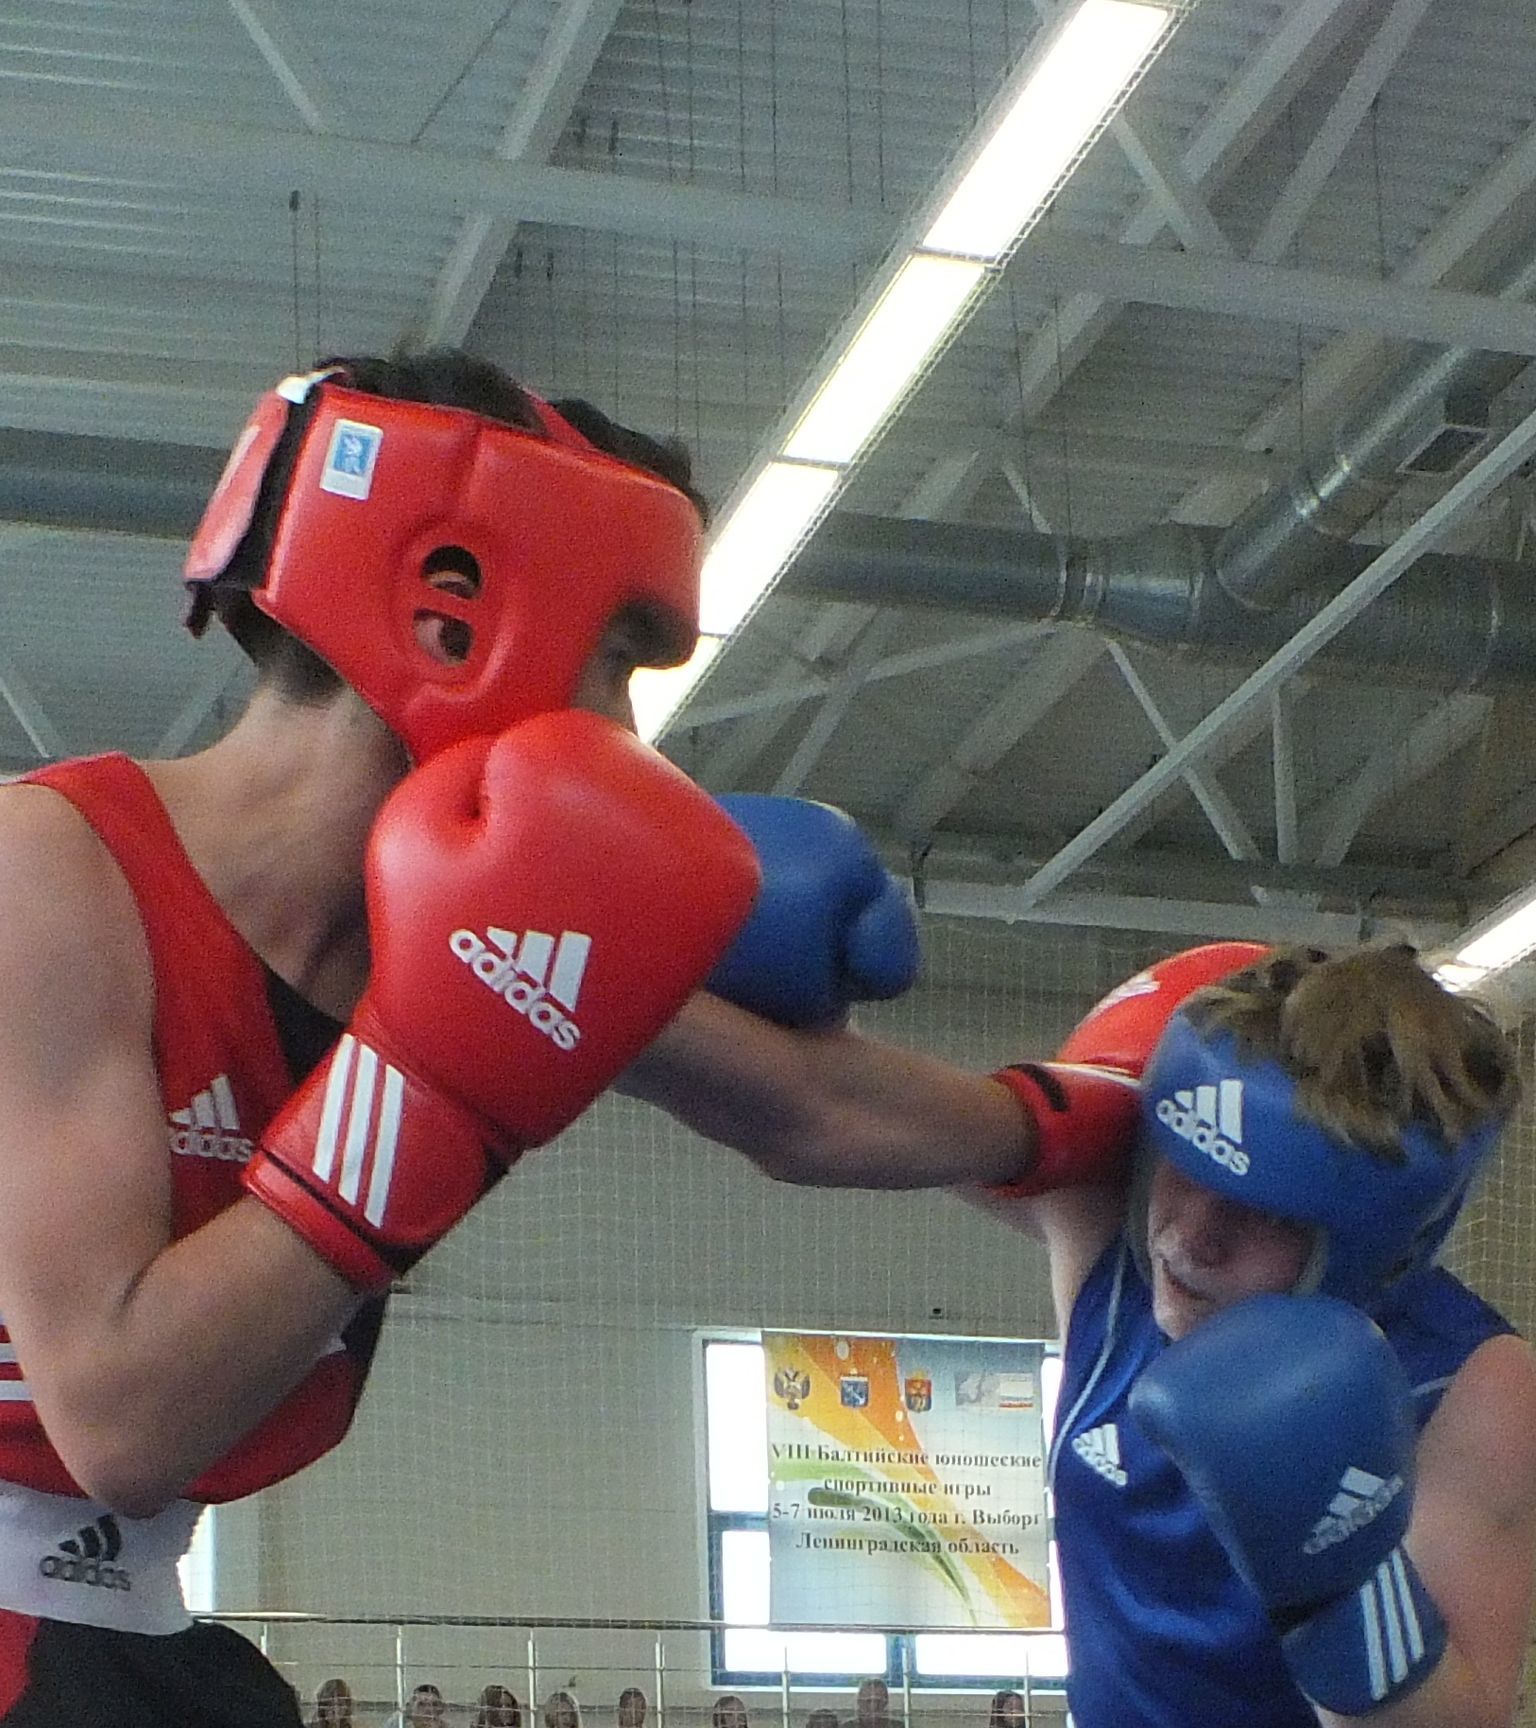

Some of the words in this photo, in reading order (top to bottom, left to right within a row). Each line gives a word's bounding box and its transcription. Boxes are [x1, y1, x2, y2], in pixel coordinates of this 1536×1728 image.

[448, 927, 581, 1050] adidas
[169, 1130, 253, 1162] adidas
[1155, 1098, 1250, 1176] adidas
[817, 1444, 929, 1465] Балтийские
[935, 1453, 1042, 1468] юношеские
[824, 1478, 937, 1496] спортивные
[944, 1483, 991, 1499] игры
[772, 1502, 800, 1519] 5-7
[807, 1507, 855, 1521] июля
[862, 1506, 903, 1523] 2013
[910, 1511, 948, 1525] года
[972, 1509, 1042, 1530] Выборг
[796, 1532, 941, 1556] Ленинградская
[948, 1537, 1019, 1554] область
[39, 1555, 131, 1592] adidas
